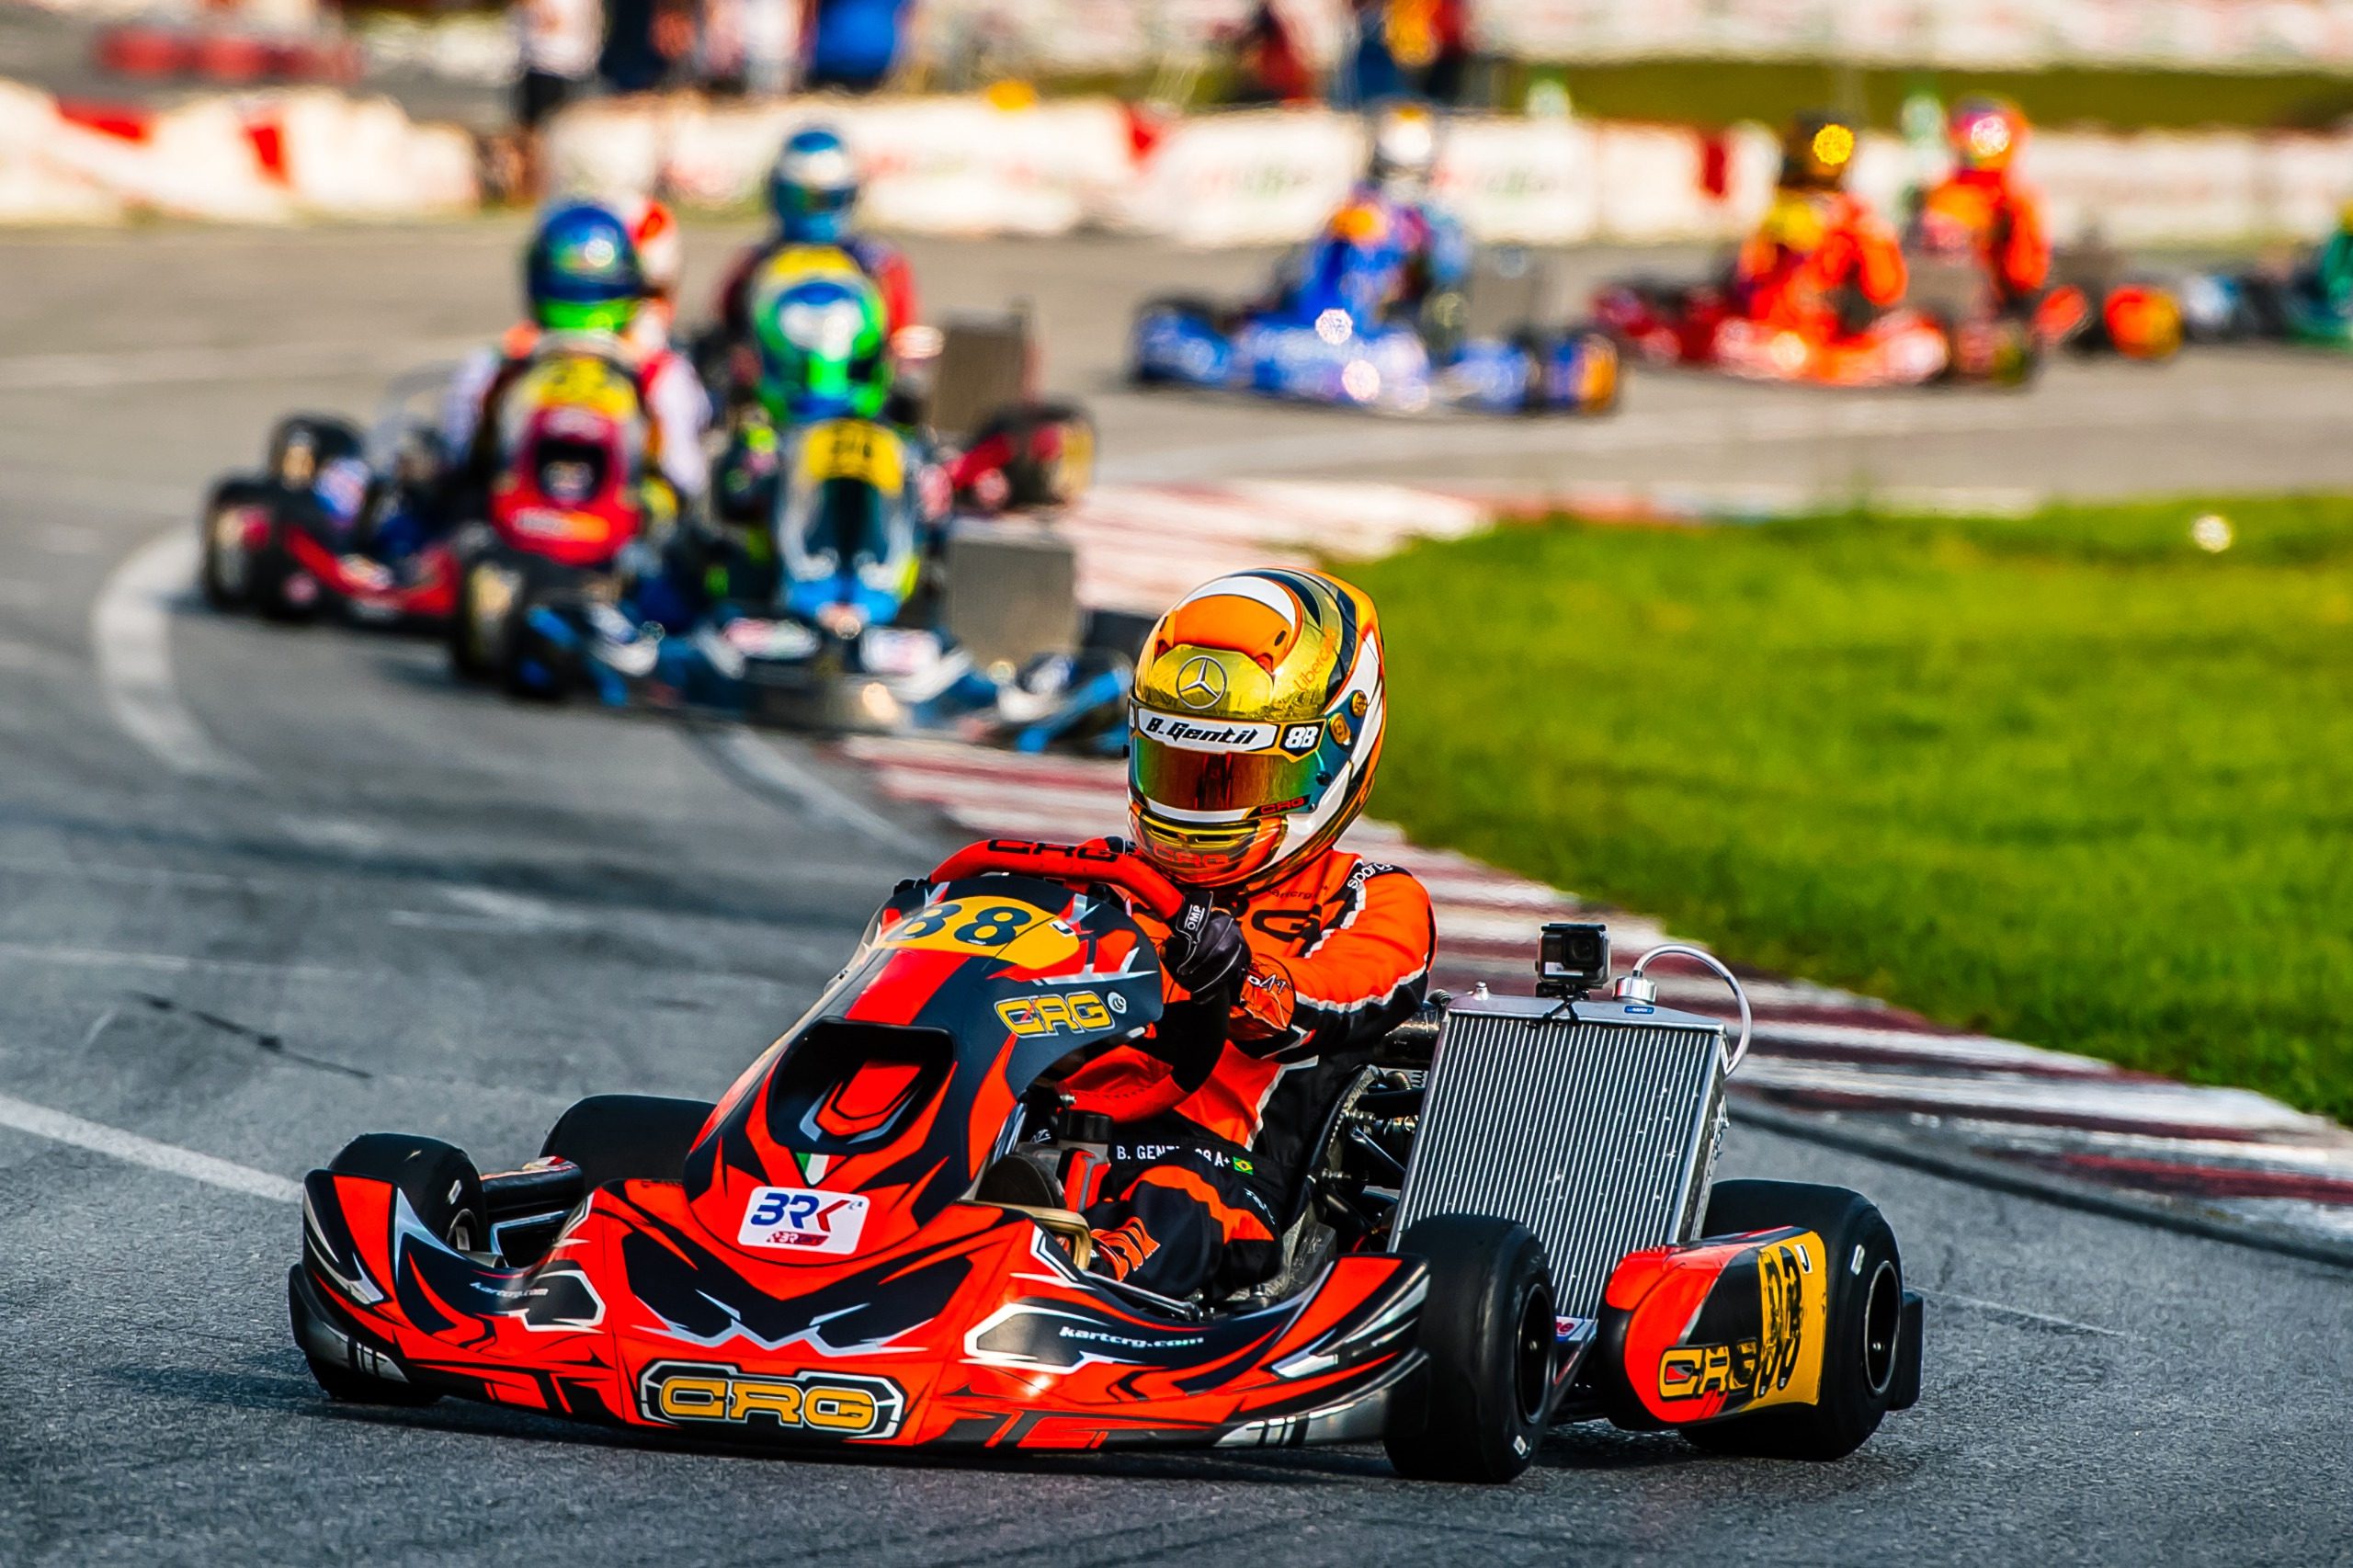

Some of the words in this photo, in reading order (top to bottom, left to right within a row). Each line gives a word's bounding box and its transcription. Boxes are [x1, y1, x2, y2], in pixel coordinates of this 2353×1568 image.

[885, 903, 1032, 947] 88
[1187, 904, 1201, 930] OMP
[995, 991, 1115, 1038] CRG
[1117, 1145, 1131, 1160] B.
[750, 1192, 851, 1233] BRK
[1059, 1325, 1204, 1348] kartcrg.com
[660, 1376, 878, 1431] CRG
